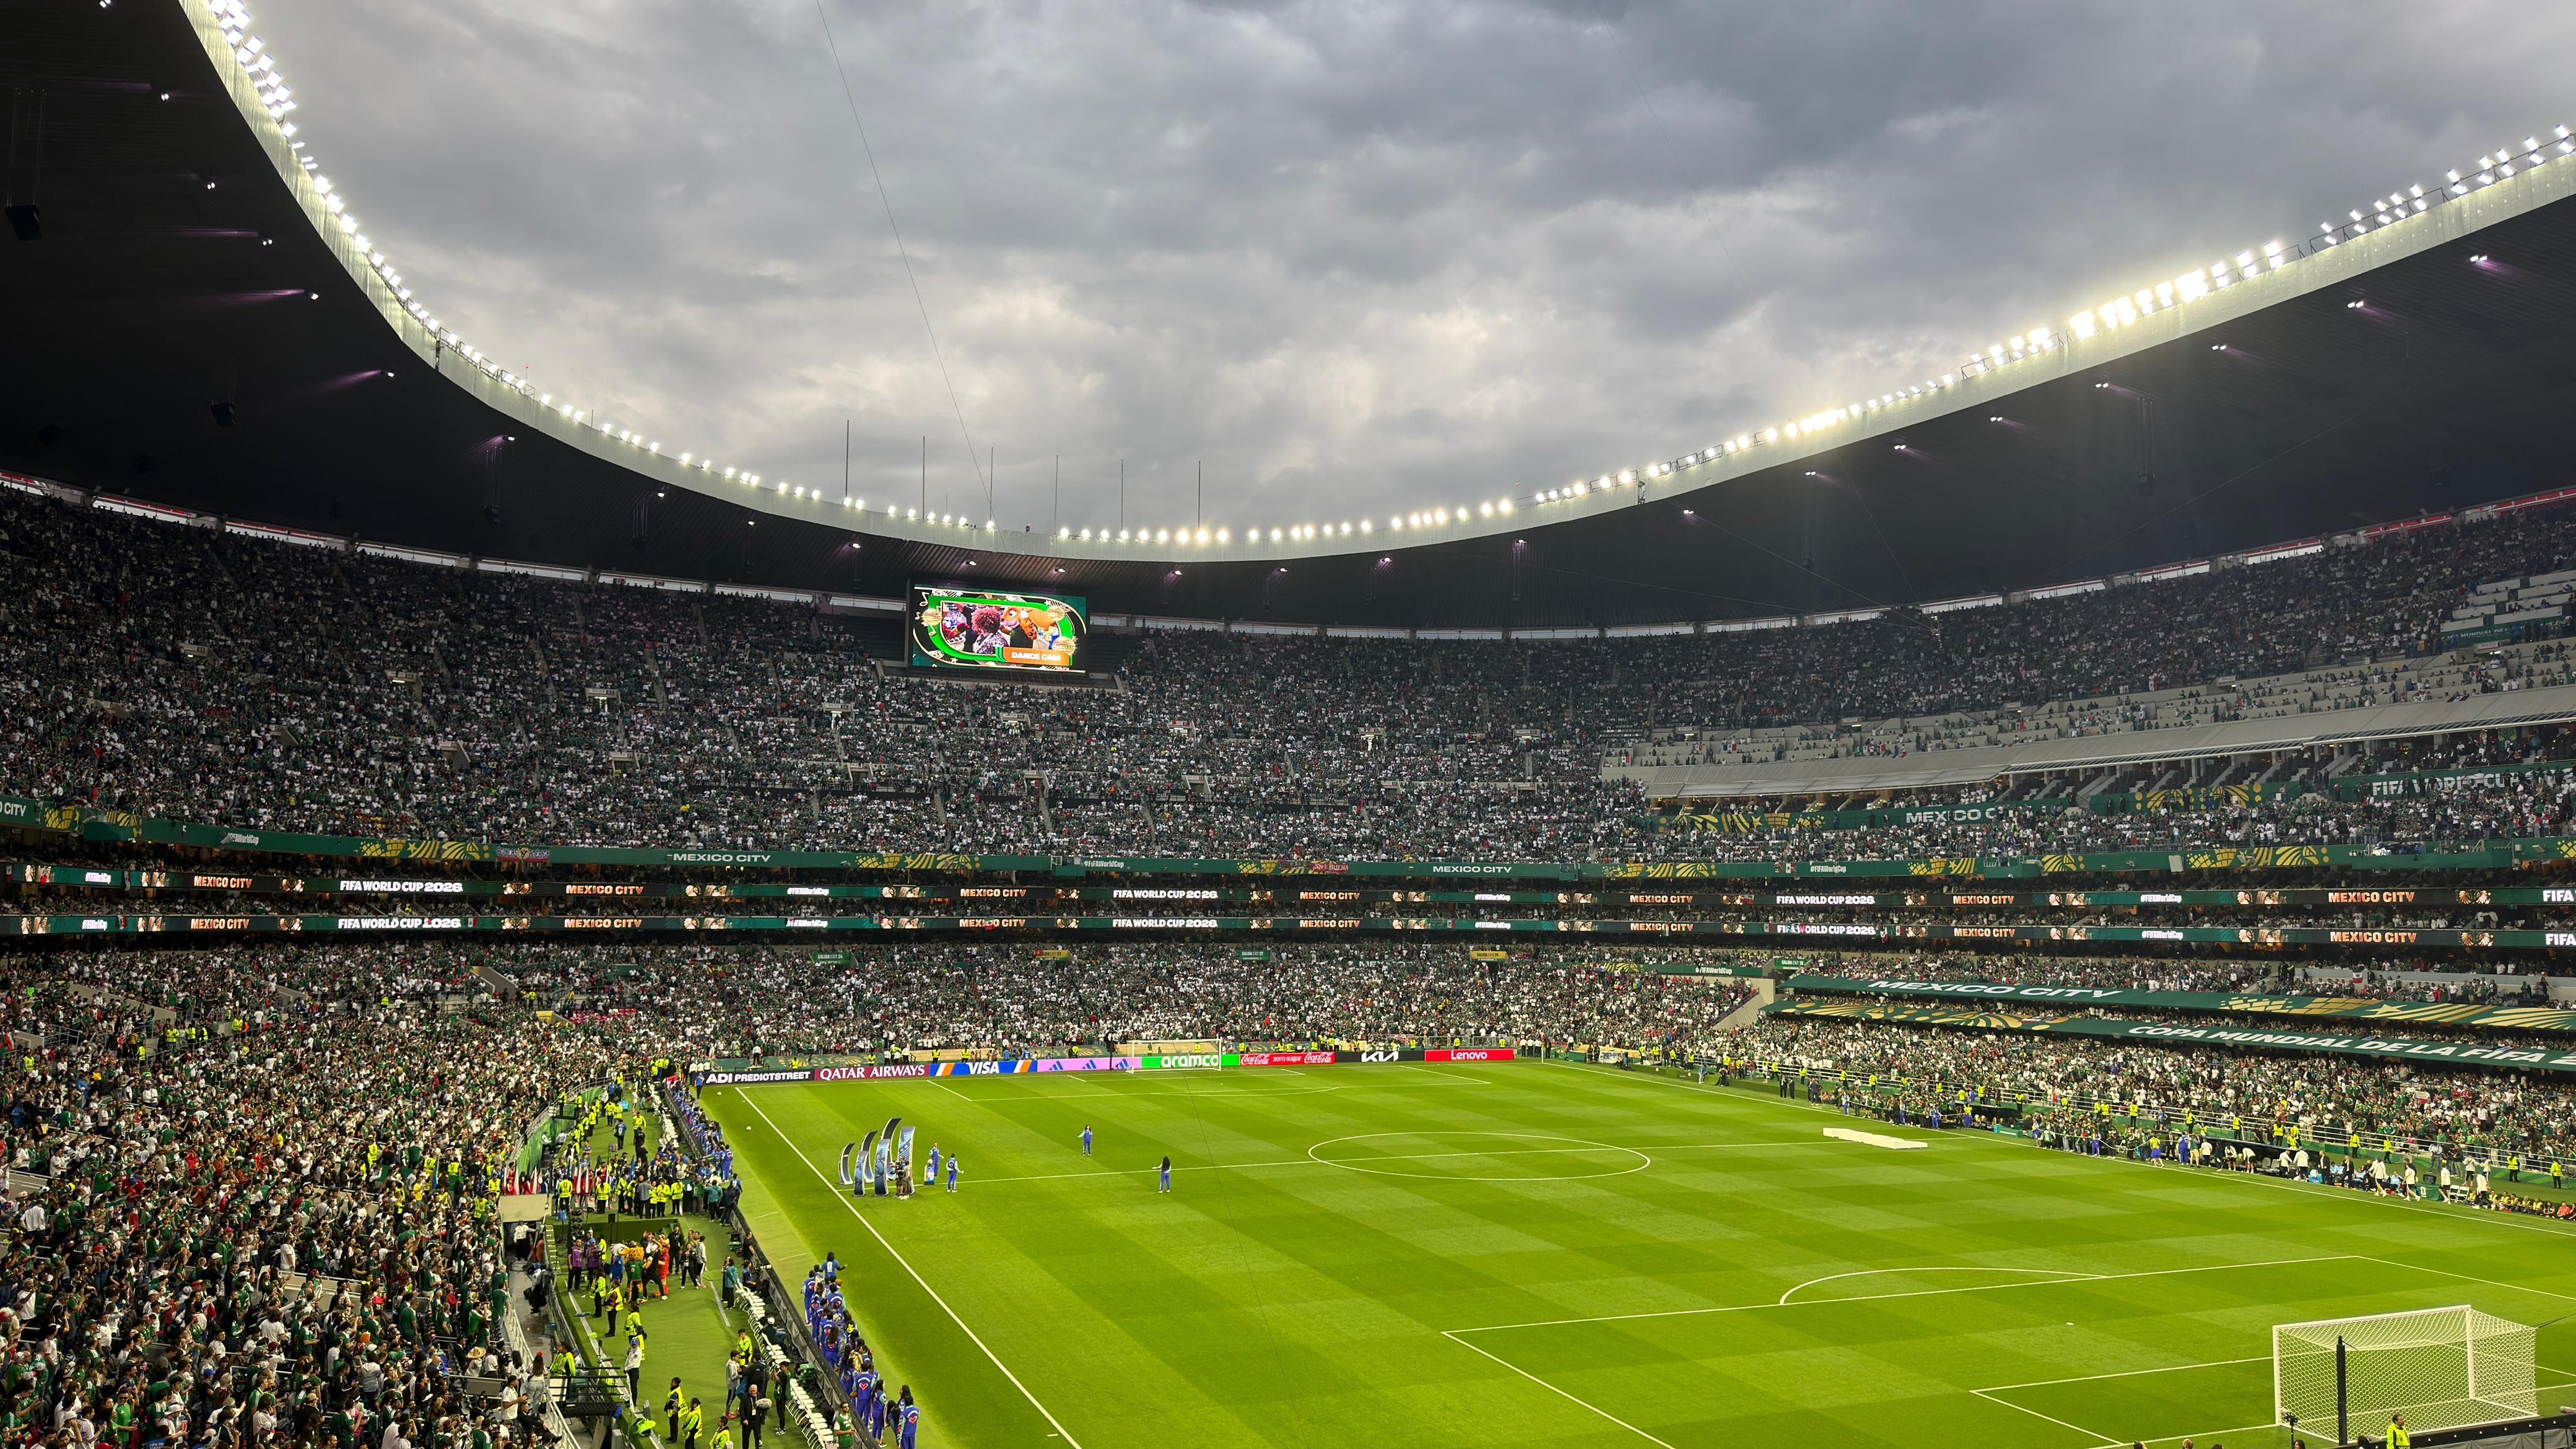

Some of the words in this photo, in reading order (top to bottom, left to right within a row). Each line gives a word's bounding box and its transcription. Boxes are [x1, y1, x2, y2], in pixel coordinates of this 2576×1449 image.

[1011, 651, 1040, 660] DANCE
[4, 802, 27, 817] CITY
[673, 853, 733, 862] MEXICO
[736, 855, 771, 863] CITY
[194, 876, 228, 887] MEXICO
[230, 877, 252, 889] CITY
[340, 880, 362, 891] FIFA
[363, 881, 398, 892] WORLD
[402, 882, 424, 892] CUP
[424, 882, 463, 892] 2026
[566, 885, 613, 894] MEXICO
[615, 886, 643, 895] CITY
[960, 889, 1001, 897] MEXICO
[1003, 889, 1027, 897] CITY
[1113, 890, 1133, 898] FIFA
[1134, 890, 1164, 899] WORLD
[1167, 890, 1185, 899] CUP
[1186, 890, 1218, 899] 2026
[1300, 892, 1336, 900] MEXICO
[1630, 895, 1668, 903] MEXICO
[1670, 895, 1693, 903] CITY
[1776, 895, 1796, 904] FIFA
[1796, 895, 1827, 905] WORLD
[1827, 896, 1845, 905] CUP
[1845, 895, 1875, 905] 2026
[1953, 895, 1990, 905] MEXICO
[1991, 895, 2014, 905] CITY
[2140, 894, 2182, 903] #FIFAWorldCup
[2328, 892, 2380, 903] MEXICO
[2383, 892, 2414, 902] CITY
[2543, 890, 2574, 902] FIFA
[191, 918, 226, 929] MEXICO
[227, 918, 250, 929] CITY
[338, 918, 360, 929] FIFA
[362, 918, 398, 929] WORLD
[401, 918, 422, 928] CUP
[422, 918, 461, 928] 2026
[564, 919, 611, 928] MEXICO
[614, 919, 642, 928] CITY
[1002, 919, 1025, 928] CITY
[1113, 919, 1133, 928] FIFA
[1134, 919, 1164, 928] WORLD
[1167, 919, 1185, 928] CUP
[1186, 919, 1218, 928] 2026
[1300, 920, 1336, 928] MEXICO
[1671, 923, 1694, 931] CITY
[1777, 925, 1795, 934] FIFA
[1796, 925, 1827, 934] WORLD
[1828, 926, 1845, 934] CUP
[1846, 926, 1876, 935] 2026
[1954, 928, 1991, 937] MEXICO
[1993, 928, 2016, 938] CITY
[2141, 930, 2183, 941] #FIFAWorldCup
[2330, 931, 2382, 942] MEXICO
[2385, 932, 2417, 943] CITY
[2545, 933, 2576, 946] FIFA
[1695, 967, 1732, 975] #FIFAWorldCup
[1867, 981, 2015, 994] MEXICO
[2019, 987, 2123, 998] CITY
[2128, 1026, 2205, 1038] COPA
[2206, 1030, 2354, 1048] MUNDIAL
[2354, 1041, 2413, 1051] DE
[2405, 1045, 2457, 1056] LA
[2458, 1048, 2546, 1063] FIFA
[1451, 1050, 1487, 1060] Lenovo
[1161, 1055, 1219, 1068] aramco
[820, 1068, 865, 1081] QATAR
[869, 1064, 925, 1077] AIRWAYS
[967, 1061, 999, 1074] VISA
[706, 1073, 733, 1084] ADI
